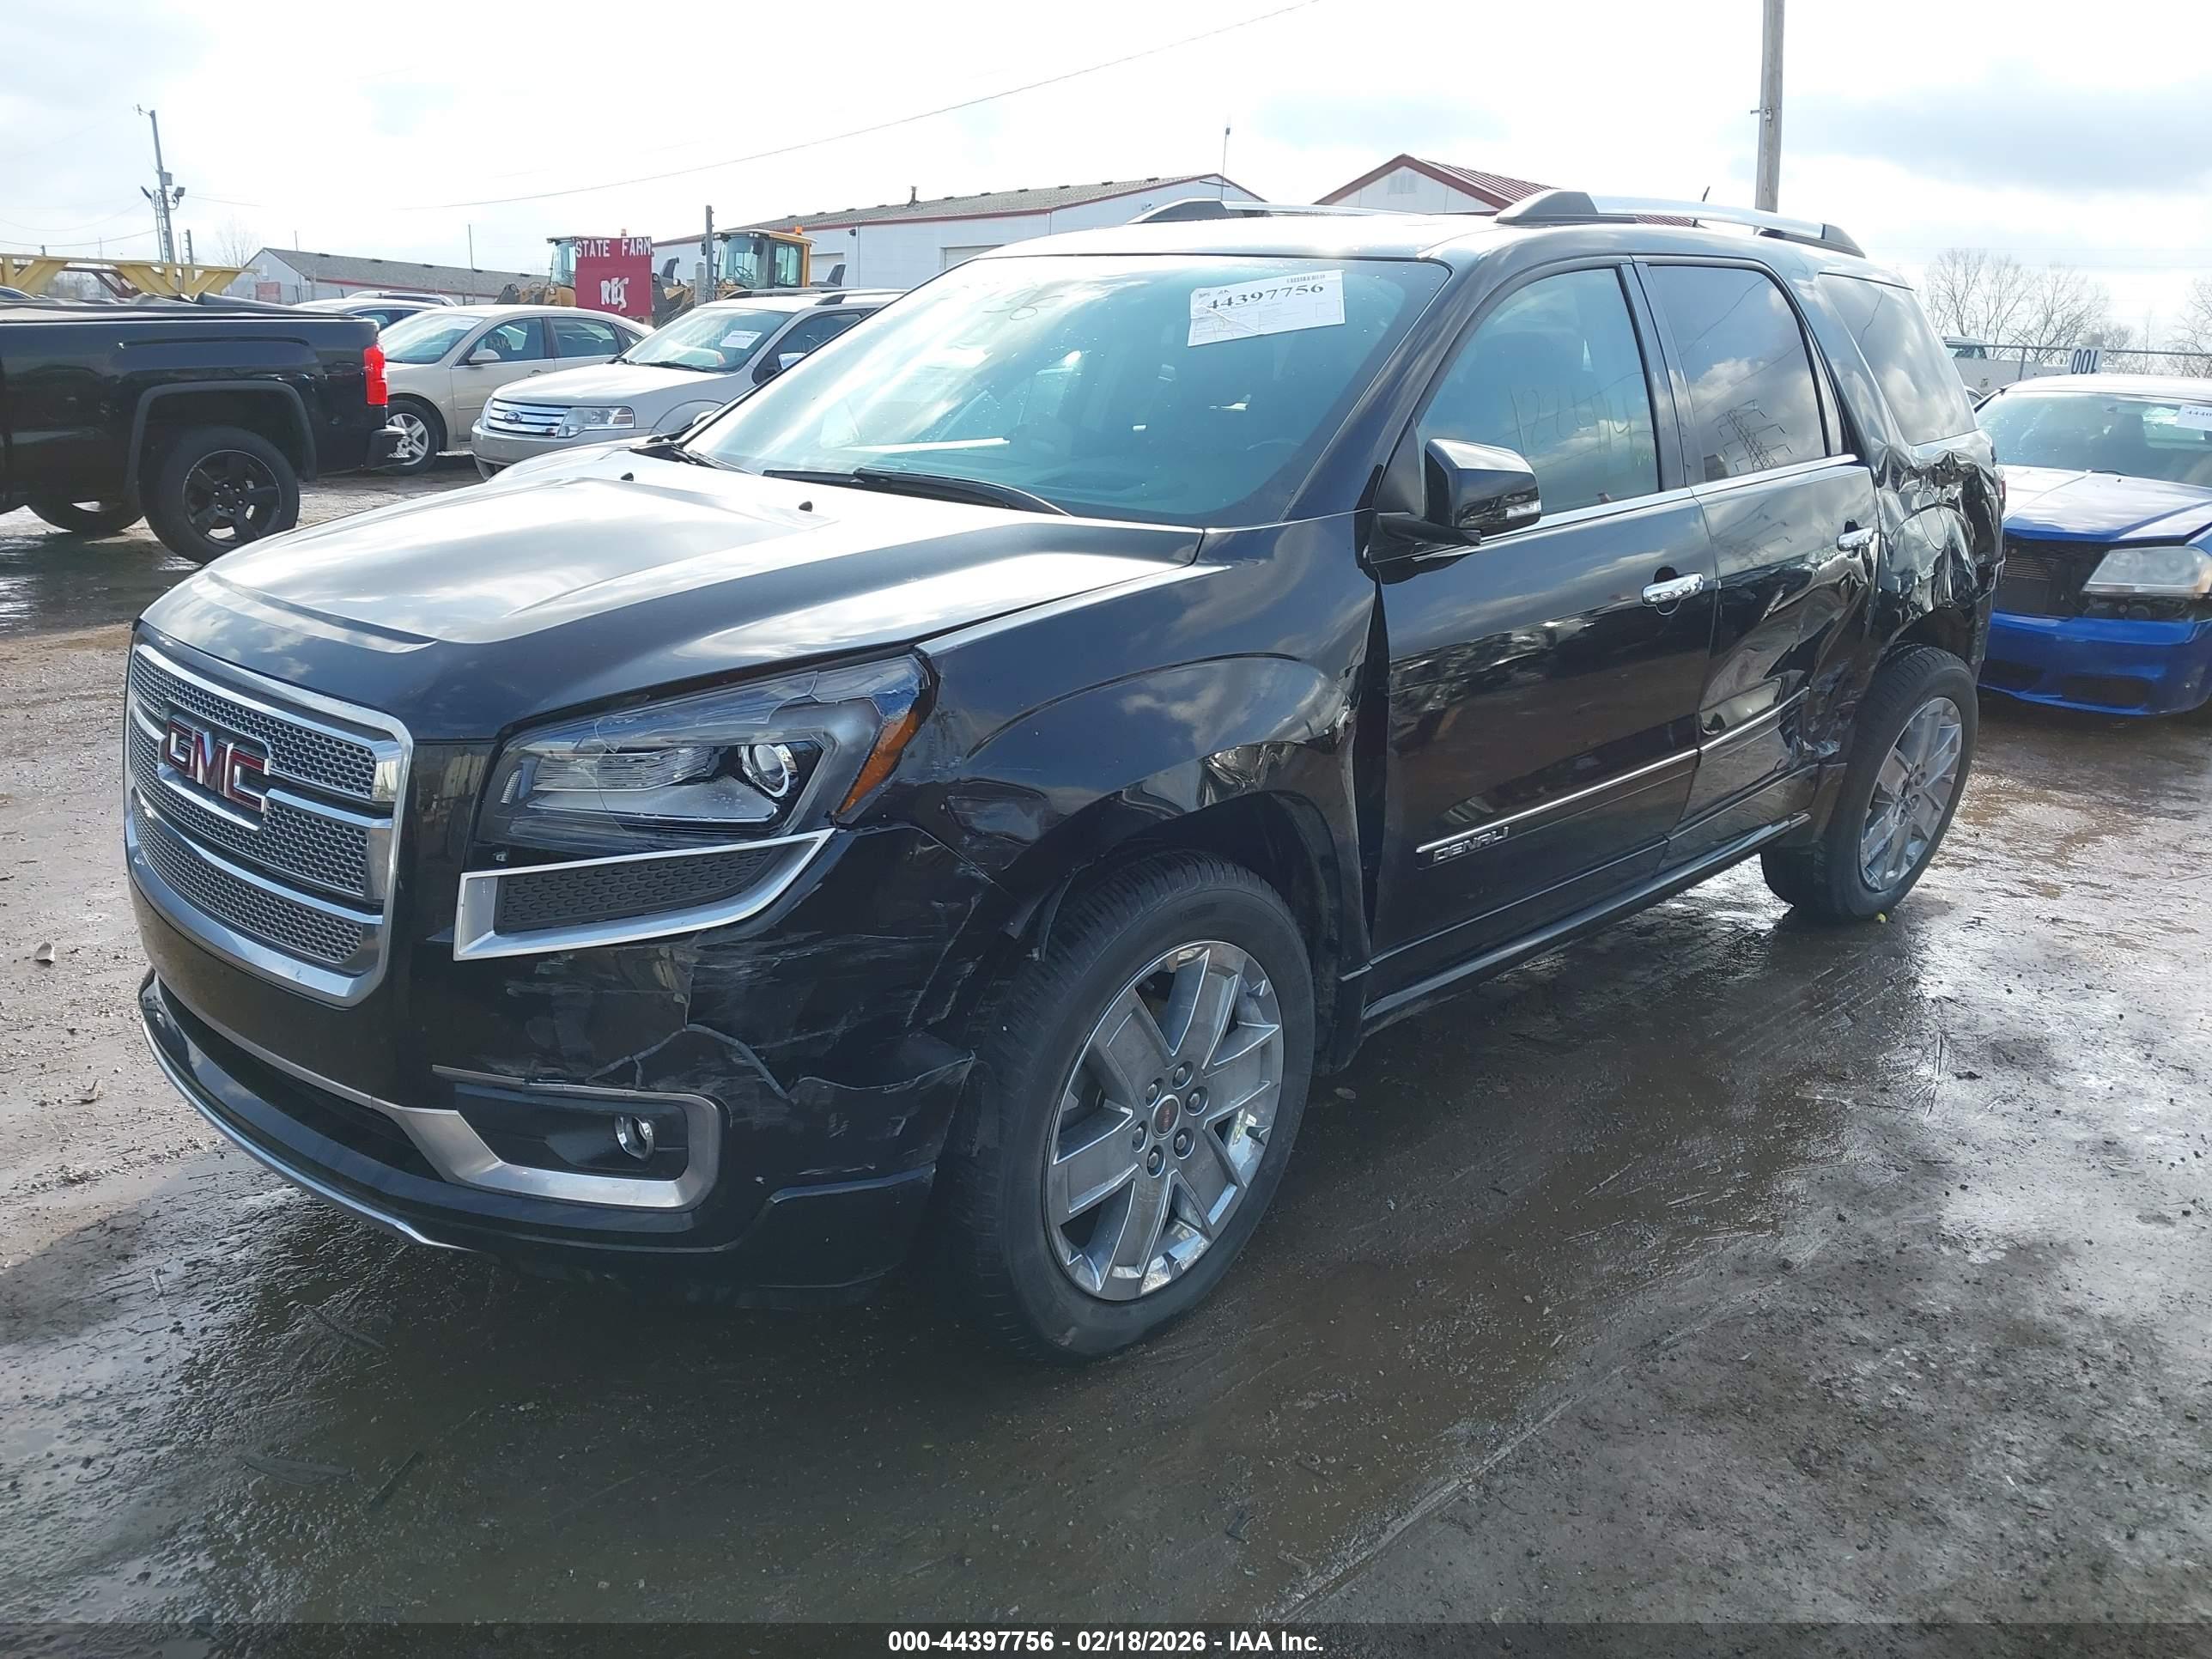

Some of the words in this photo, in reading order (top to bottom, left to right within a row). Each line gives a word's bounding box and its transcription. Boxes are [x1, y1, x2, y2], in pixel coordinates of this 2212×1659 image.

[575, 240, 611, 258] STATE
[622, 238, 652, 257] FARM
[1206, 283, 1325, 310] 44397756
[166, 714, 270, 813] GMC
[1432, 825, 1510, 863] DENALI
